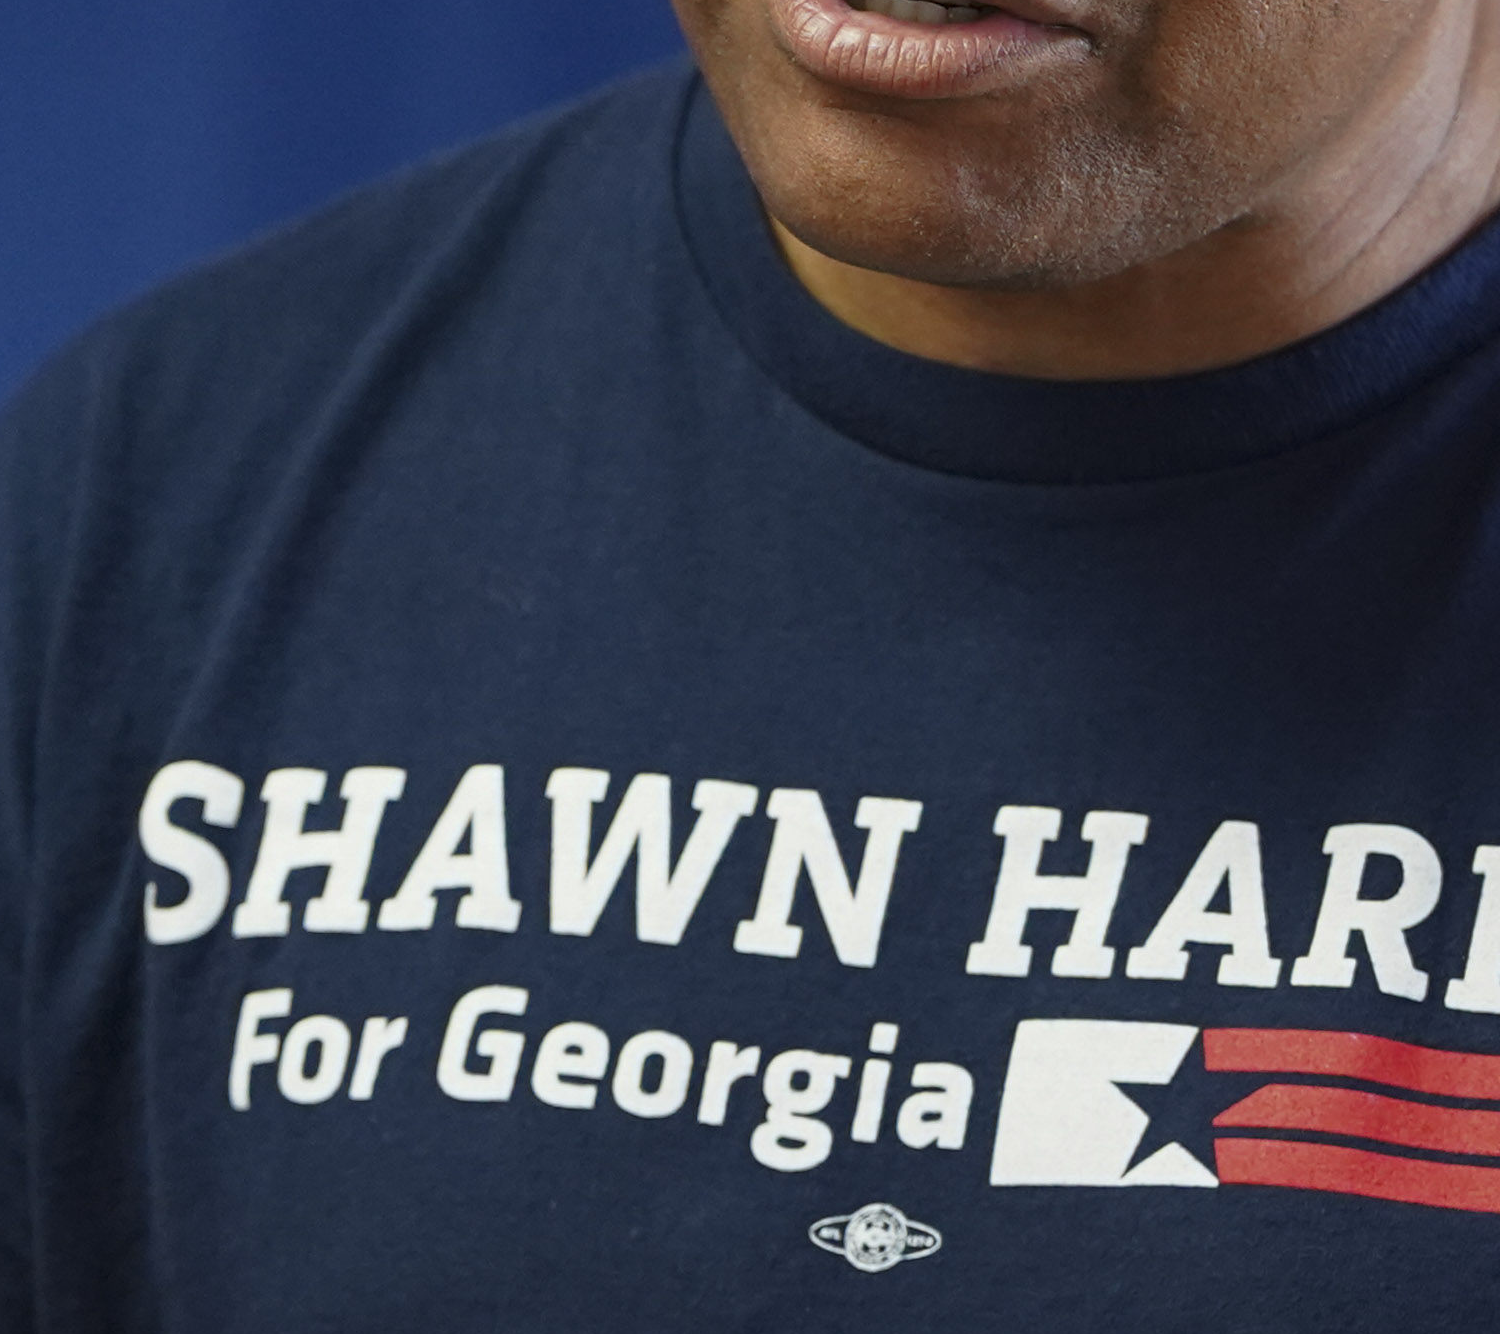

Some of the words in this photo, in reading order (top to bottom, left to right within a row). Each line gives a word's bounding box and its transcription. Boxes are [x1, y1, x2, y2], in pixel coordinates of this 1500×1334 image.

[138, 760, 923, 969] SHAWN
[228, 984, 409, 1111] For
[436, 984, 974, 1173] Georgia
